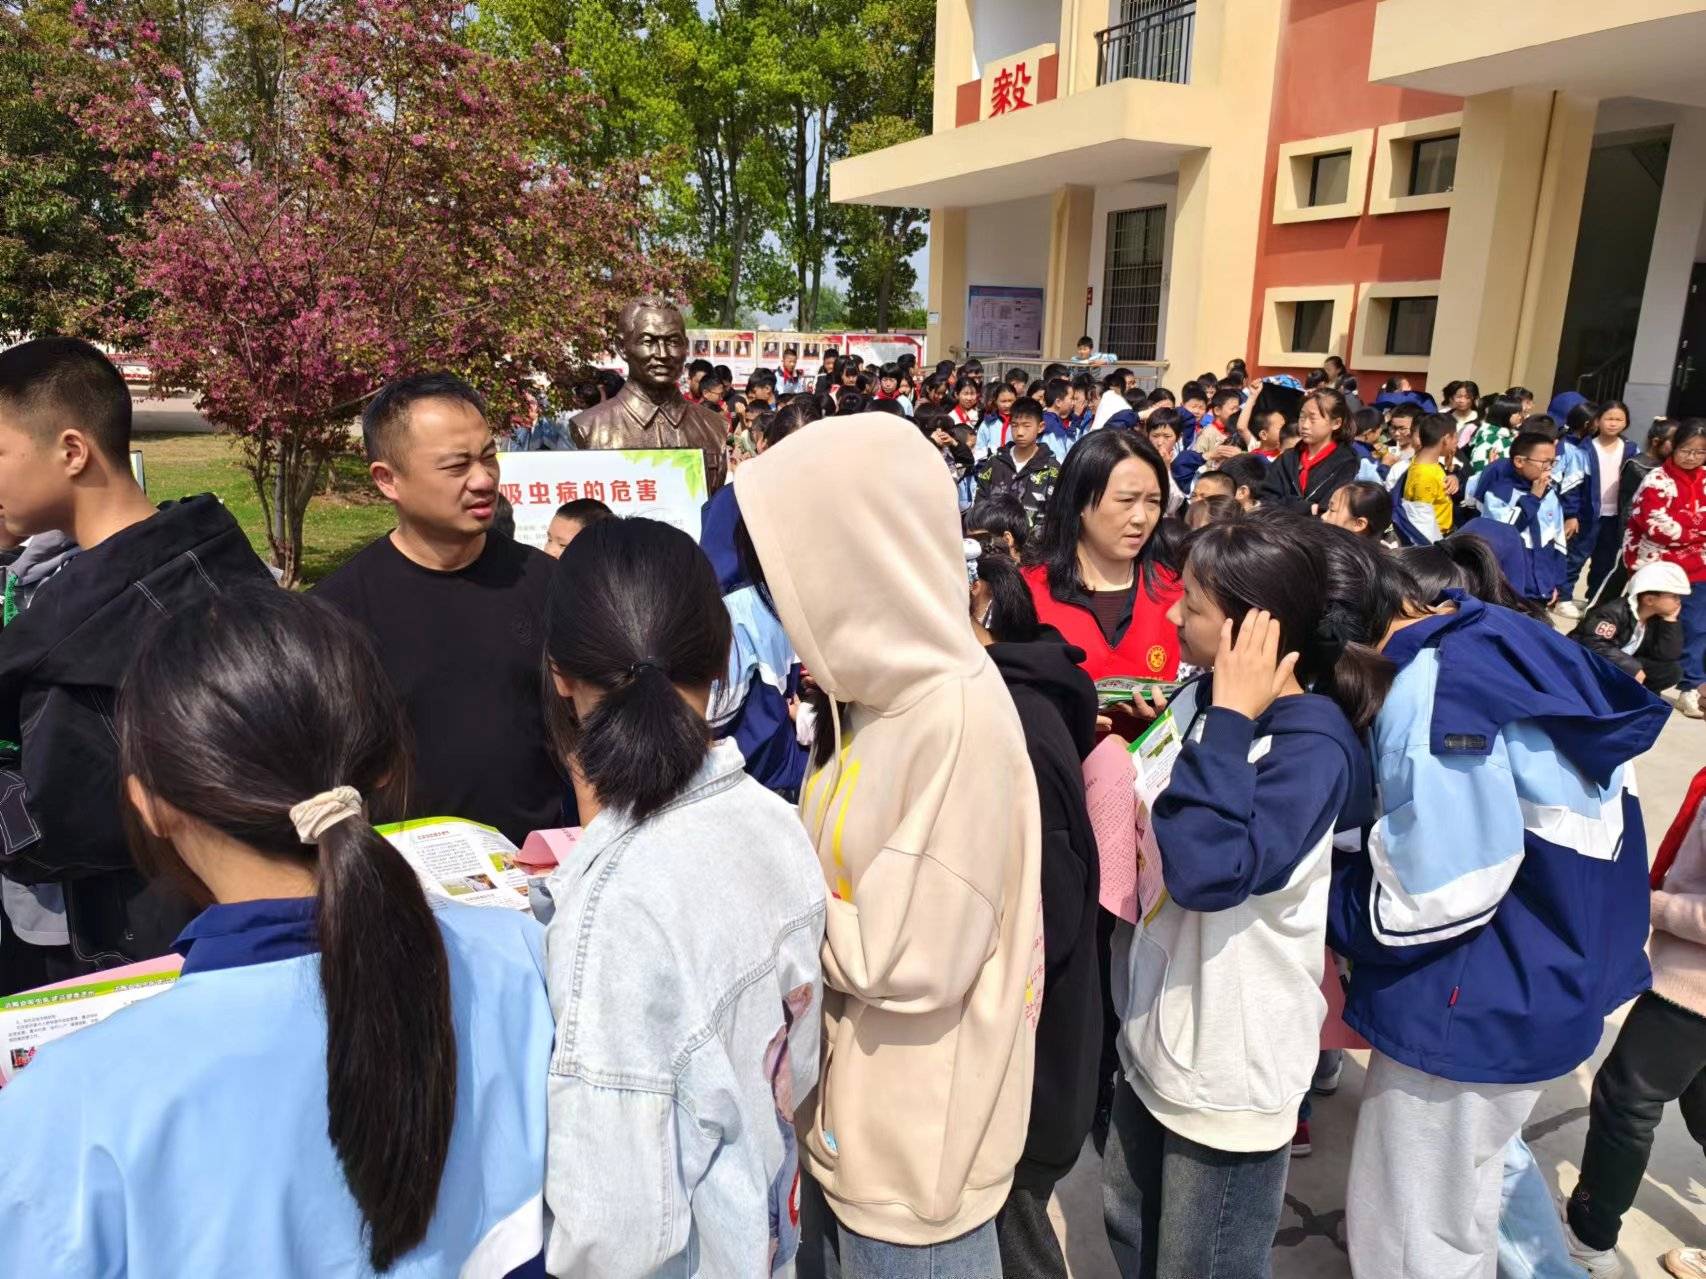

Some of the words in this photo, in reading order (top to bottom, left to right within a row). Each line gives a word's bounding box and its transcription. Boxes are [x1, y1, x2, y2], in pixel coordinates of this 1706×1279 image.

[989, 62, 1033, 118] 毅
[500, 479, 657, 505] 吸虫病的危害
